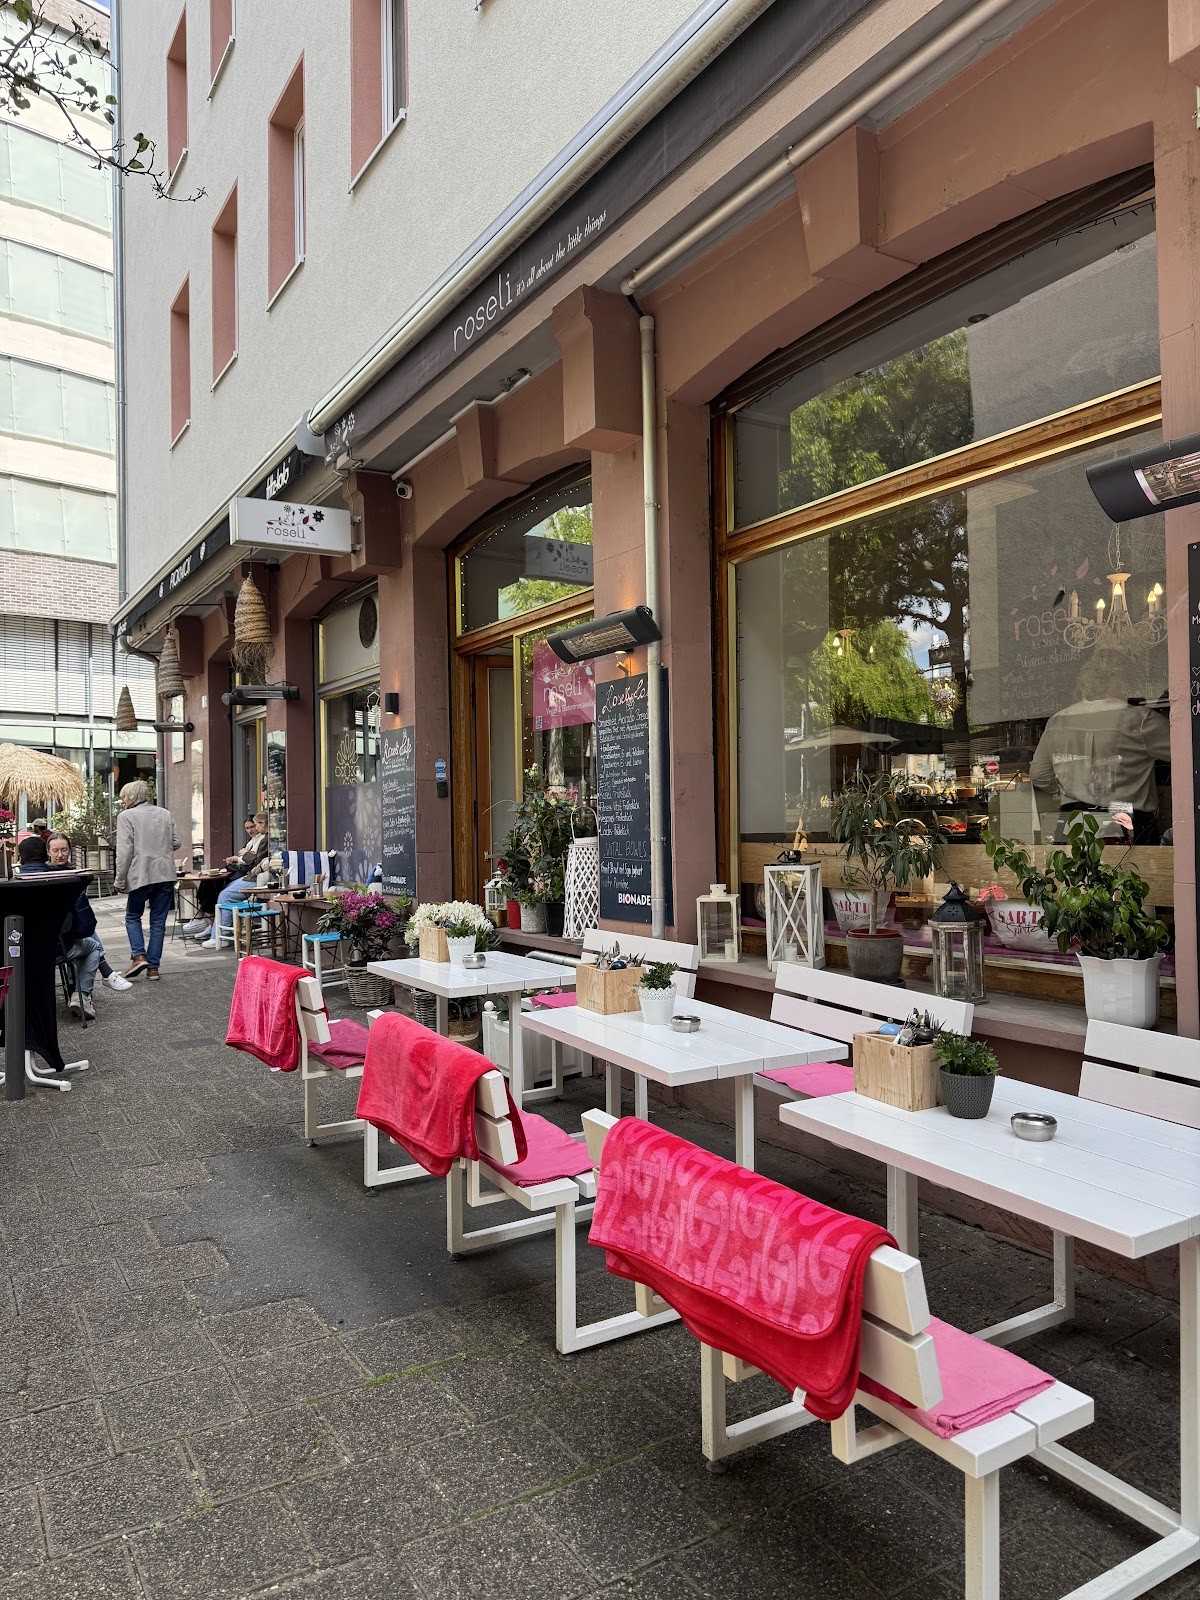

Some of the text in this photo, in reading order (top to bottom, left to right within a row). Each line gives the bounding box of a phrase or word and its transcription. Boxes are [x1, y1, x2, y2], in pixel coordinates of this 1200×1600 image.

[453, 273, 513, 352] roseli
[526, 266, 536, 288] all
[536, 254, 555, 279] about
[555, 242, 566, 262] the
[567, 226, 582, 252] little
[584, 209, 606, 237] things
[266, 526, 306, 539] roseli
[543, 673, 582, 703] roseli
[605, 841, 648, 858] VITAL BOWLS
[618, 892, 651, 906] BIONADE
[834, 900, 867, 914] SARTI
[998, 910, 1044, 925] SART
